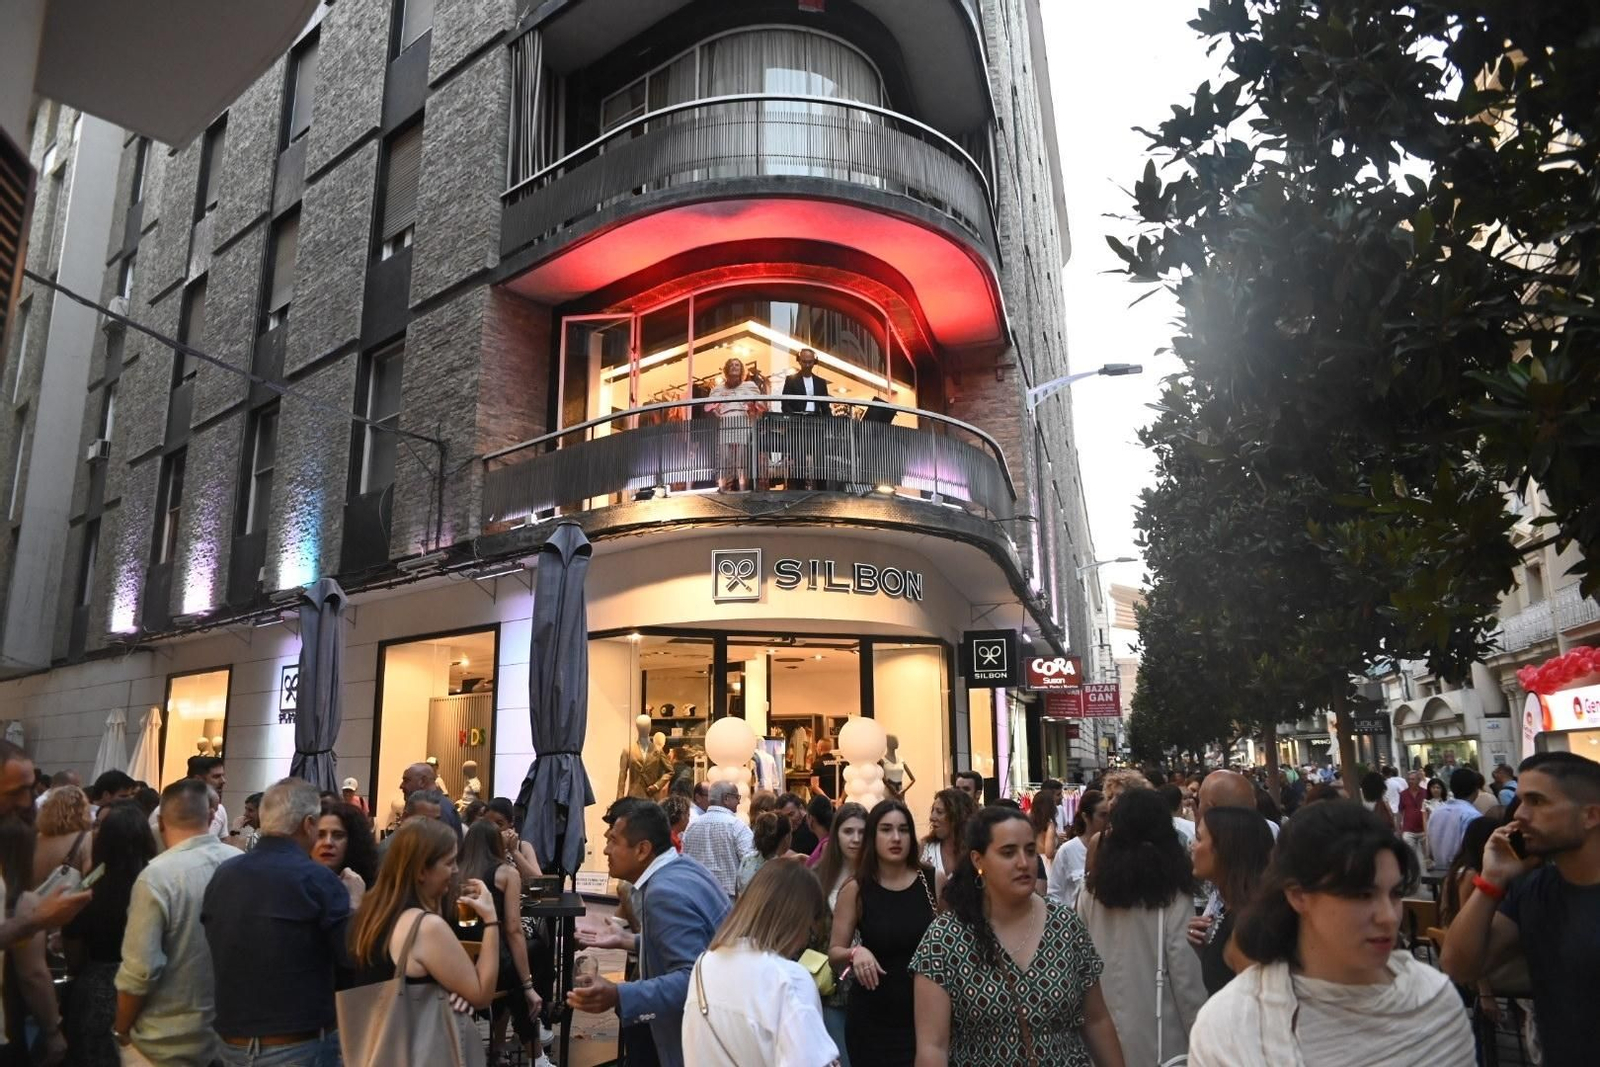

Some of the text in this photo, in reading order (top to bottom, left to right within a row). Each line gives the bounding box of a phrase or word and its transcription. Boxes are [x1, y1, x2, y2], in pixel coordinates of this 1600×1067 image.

[774, 559, 923, 600] SILBON
[974, 672, 1008, 680] SILBON
[1085, 685, 1116, 693] BAZAR
[1089, 693, 1114, 702] GAN
